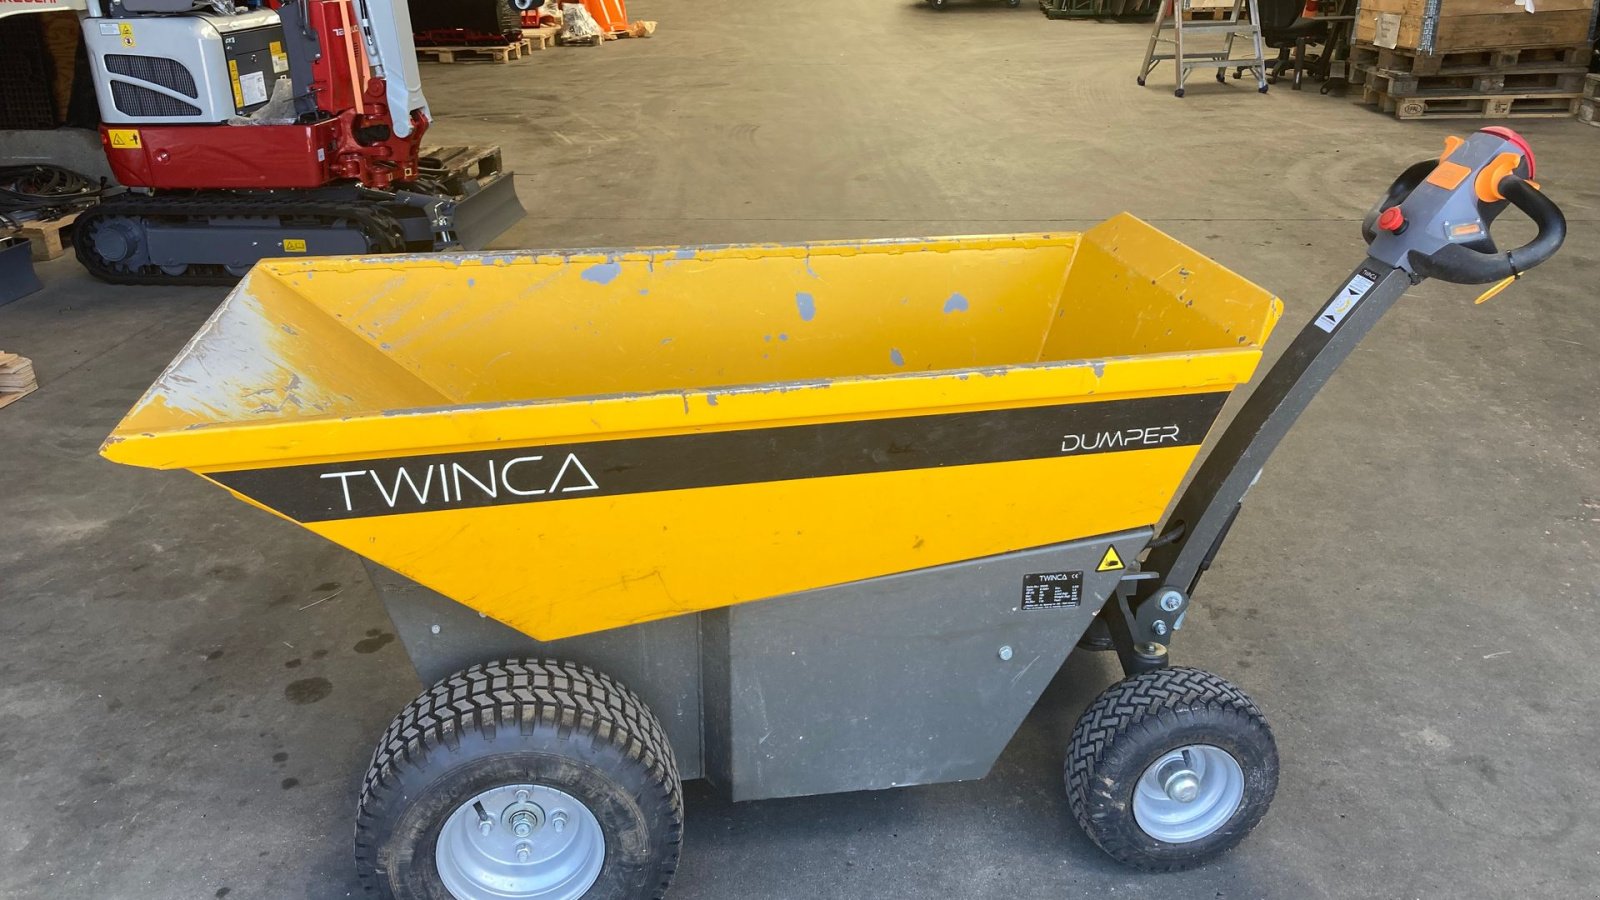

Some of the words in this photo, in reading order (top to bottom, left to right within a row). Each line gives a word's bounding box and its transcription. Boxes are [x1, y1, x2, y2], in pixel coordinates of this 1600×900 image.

[1061, 424, 1179, 452] DUMPER
[320, 452, 599, 511] TWINCA
[1039, 573, 1068, 582] TWINCA
